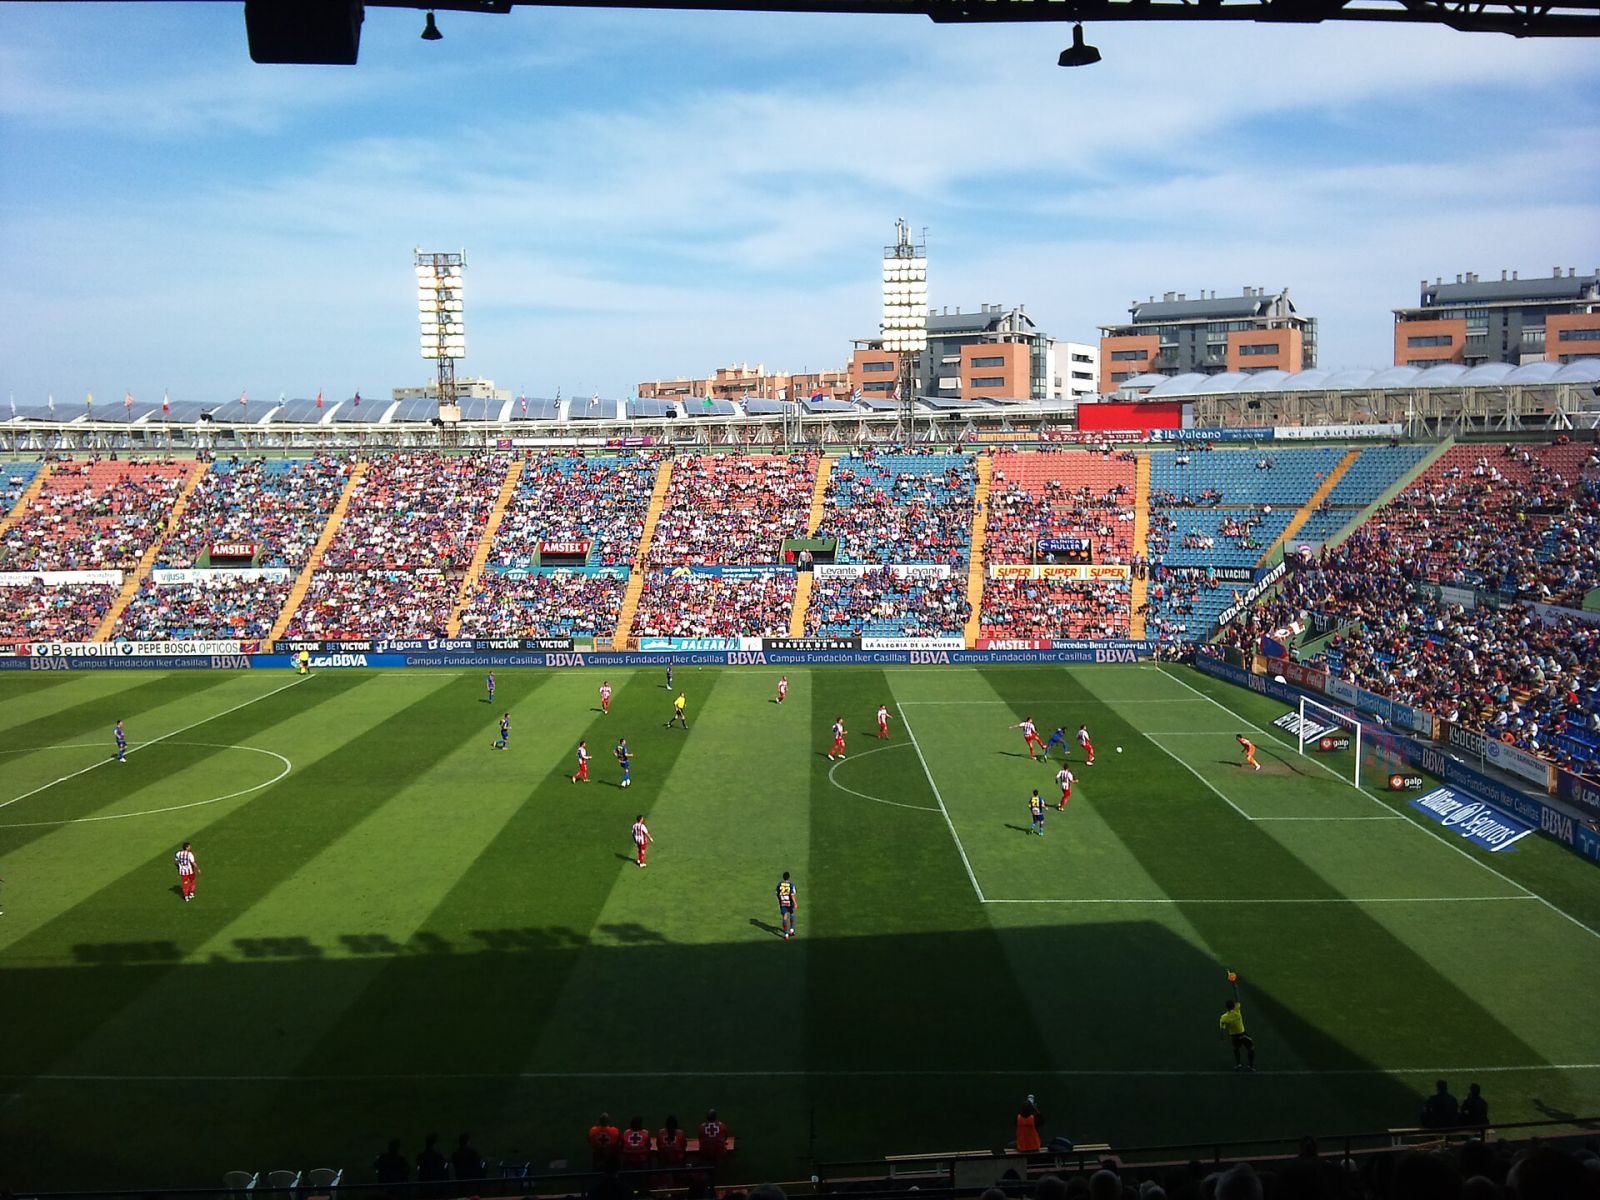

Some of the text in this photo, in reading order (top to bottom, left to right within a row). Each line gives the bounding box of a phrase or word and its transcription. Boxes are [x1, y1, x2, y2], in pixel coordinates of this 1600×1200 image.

[1178, 430, 1220, 438] Vulcano
[212, 545, 251, 554] AMSTEL
[543, 543, 580, 552] AMSTEL
[820, 566, 856, 574] Levante
[906, 566, 943, 574] Levante
[998, 568, 1031, 576] SUPER
[1044, 568, 1077, 576] SUPER
[1090, 568, 1124, 576] SUPER
[160, 572, 185, 581] vijusa
[138, 643, 238, 654] PEPE BOSCA OPTICOS
[276, 642, 319, 651] BETVICTOR
[326, 642, 370, 650] BETVICTOR
[390, 641, 422, 650] ágora
[440, 640, 471, 650] ágora
[476, 640, 519, 649] BETVICTOR
[526, 640, 569, 649] BETVICTOR
[988, 640, 1030, 650] AMSTEL
[407, 657, 441, 666] Campus
[444, 656, 488, 665] Fundación
[510, 656, 542, 664] Casillas
[546, 654, 584, 666] BBVA
[588, 656, 623, 665] Campus
[626, 656, 670, 664] Fundación
[728, 652, 767, 664] BBVA
[770, 655, 805, 664] Campus
[807, 654, 852, 662] Fundación
[910, 651, 950, 664] BBVA
[953, 654, 988, 663] Campus
[991, 653, 1036, 661] Fundación
[1096, 650, 1136, 662] BBVA
[30, 657, 69, 670] BBVA
[72, 659, 107, 669] Campus
[110, 658, 151, 667] Fundación
[175, 659, 208, 667] Casillas
[211, 656, 250, 668] BBVA
[1333, 739, 1349, 748] galp
[1422, 748, 1445, 778] BBVA
[1404, 777, 1422, 788] galp
[1416, 788, 1463, 816] Allianz
[1460, 810, 1516, 845] Seguros
[1540, 806, 1573, 845] BBVA
